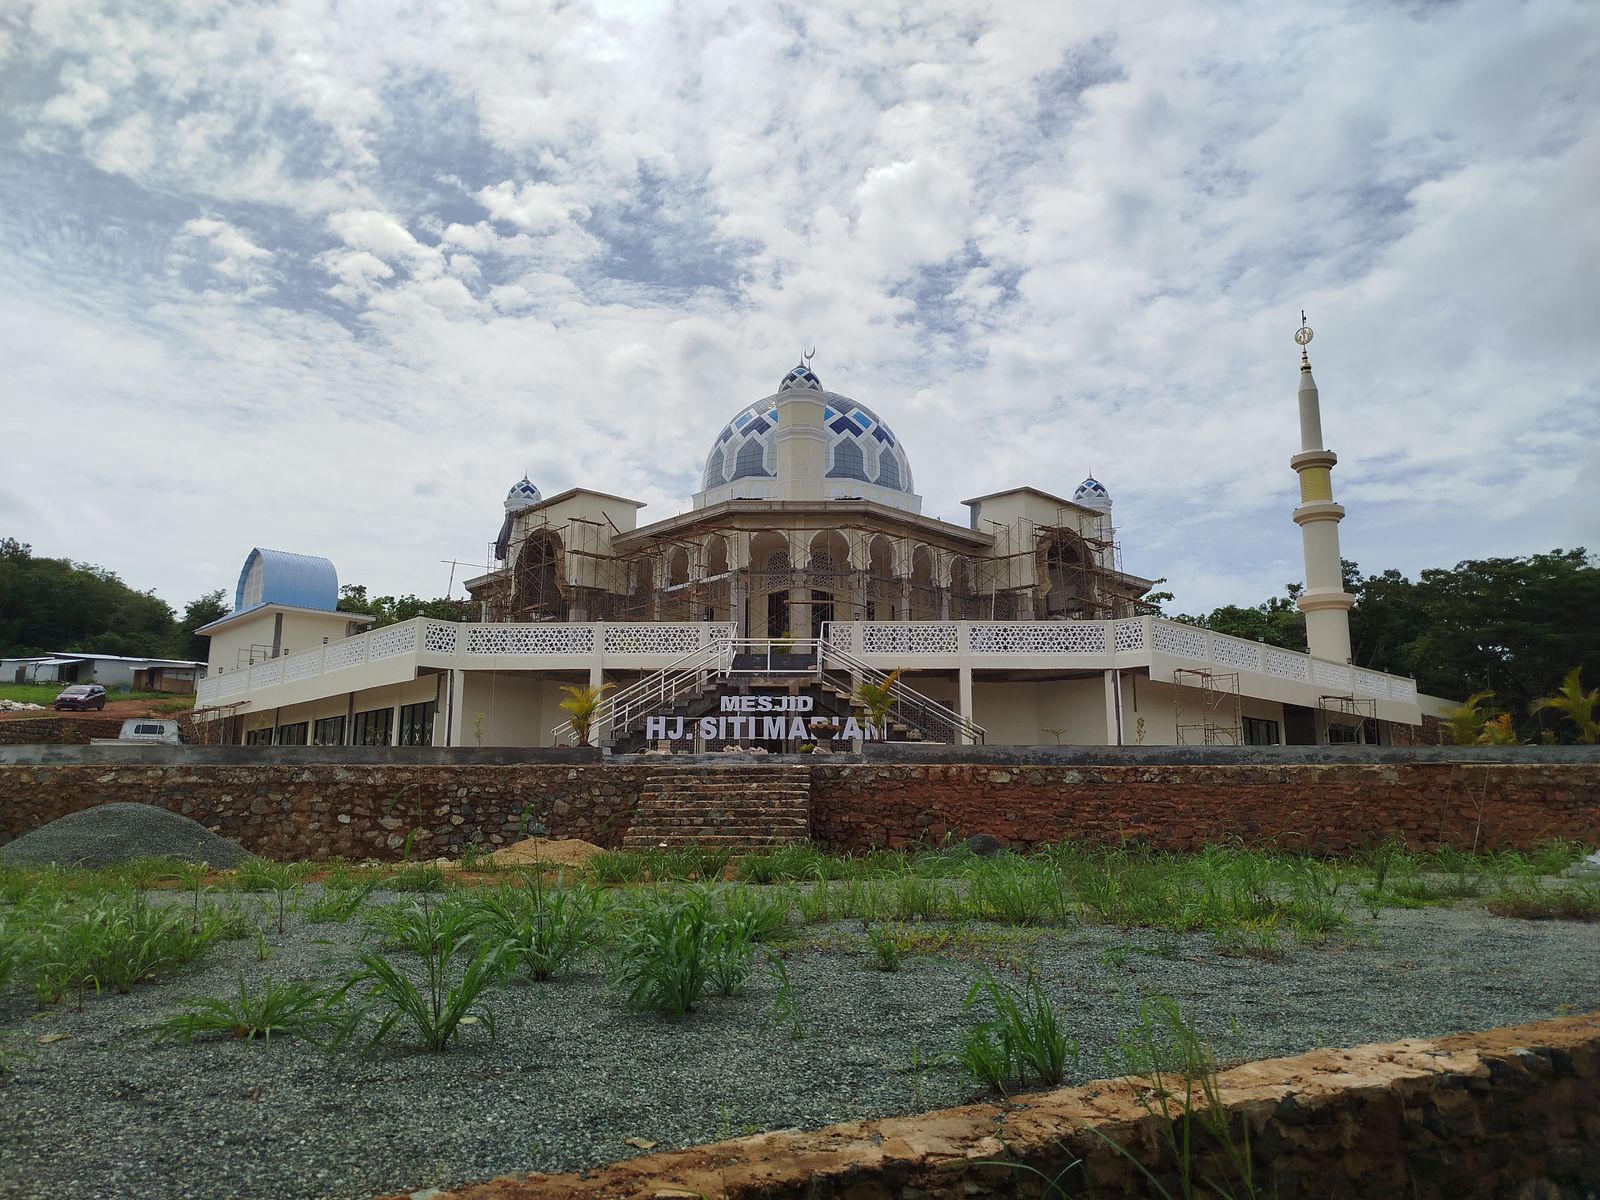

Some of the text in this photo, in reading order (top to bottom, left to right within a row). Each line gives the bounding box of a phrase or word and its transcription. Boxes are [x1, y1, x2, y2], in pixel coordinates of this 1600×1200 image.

[720, 695, 813, 712] MESJID
[646, 716, 693, 740] HJ.
[700, 716, 756, 740] SITI
